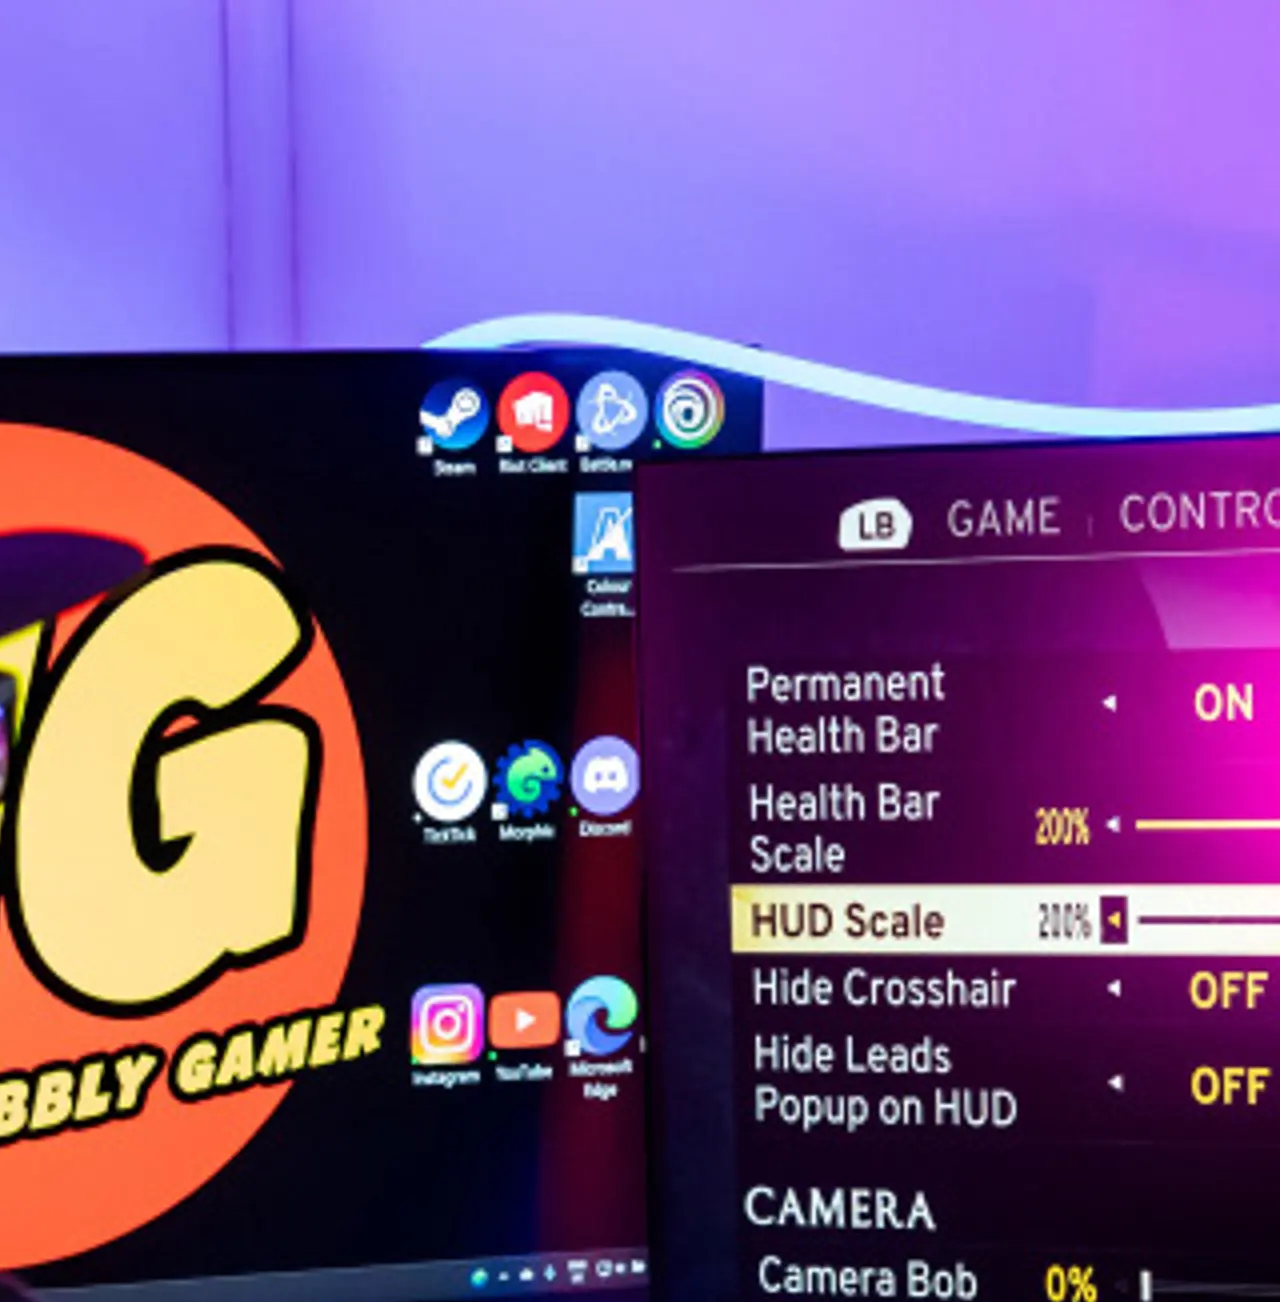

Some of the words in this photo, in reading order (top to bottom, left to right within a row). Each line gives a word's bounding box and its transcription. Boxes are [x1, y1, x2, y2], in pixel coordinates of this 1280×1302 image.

[858, 512, 896, 541] LB
[948, 498, 1061, 537] GAME
[748, 663, 945, 702] Permanent
[1194, 684, 1254, 721] ON
[749, 717, 865, 755] Health
[876, 718, 939, 753] Bar
[750, 783, 865, 821] Health
[879, 785, 941, 821] Bar
[1035, 808, 1091, 845] 200%
[751, 836, 846, 873] Scale
[751, 904, 832, 940] HUD
[845, 903, 946, 940] Scale
[1038, 903, 1093, 940] 200%
[754, 968, 833, 1006] Hide
[844, 970, 1016, 1008] Crosshair
[1190, 971, 1269, 1010] OFF
[175, 1003, 387, 1096] GAMER
[755, 1035, 834, 1073] Hide
[846, 1036, 952, 1075] Leads
[1191, 1067, 1271, 1105] OFF
[756, 1086, 869, 1133] Popup
[879, 1095, 922, 1127] on
[935, 1089, 1018, 1128] HUD
[745, 1185, 937, 1231] CAMERA
[759, 1256, 897, 1298] Camera
[907, 1260, 978, 1301] Bob
